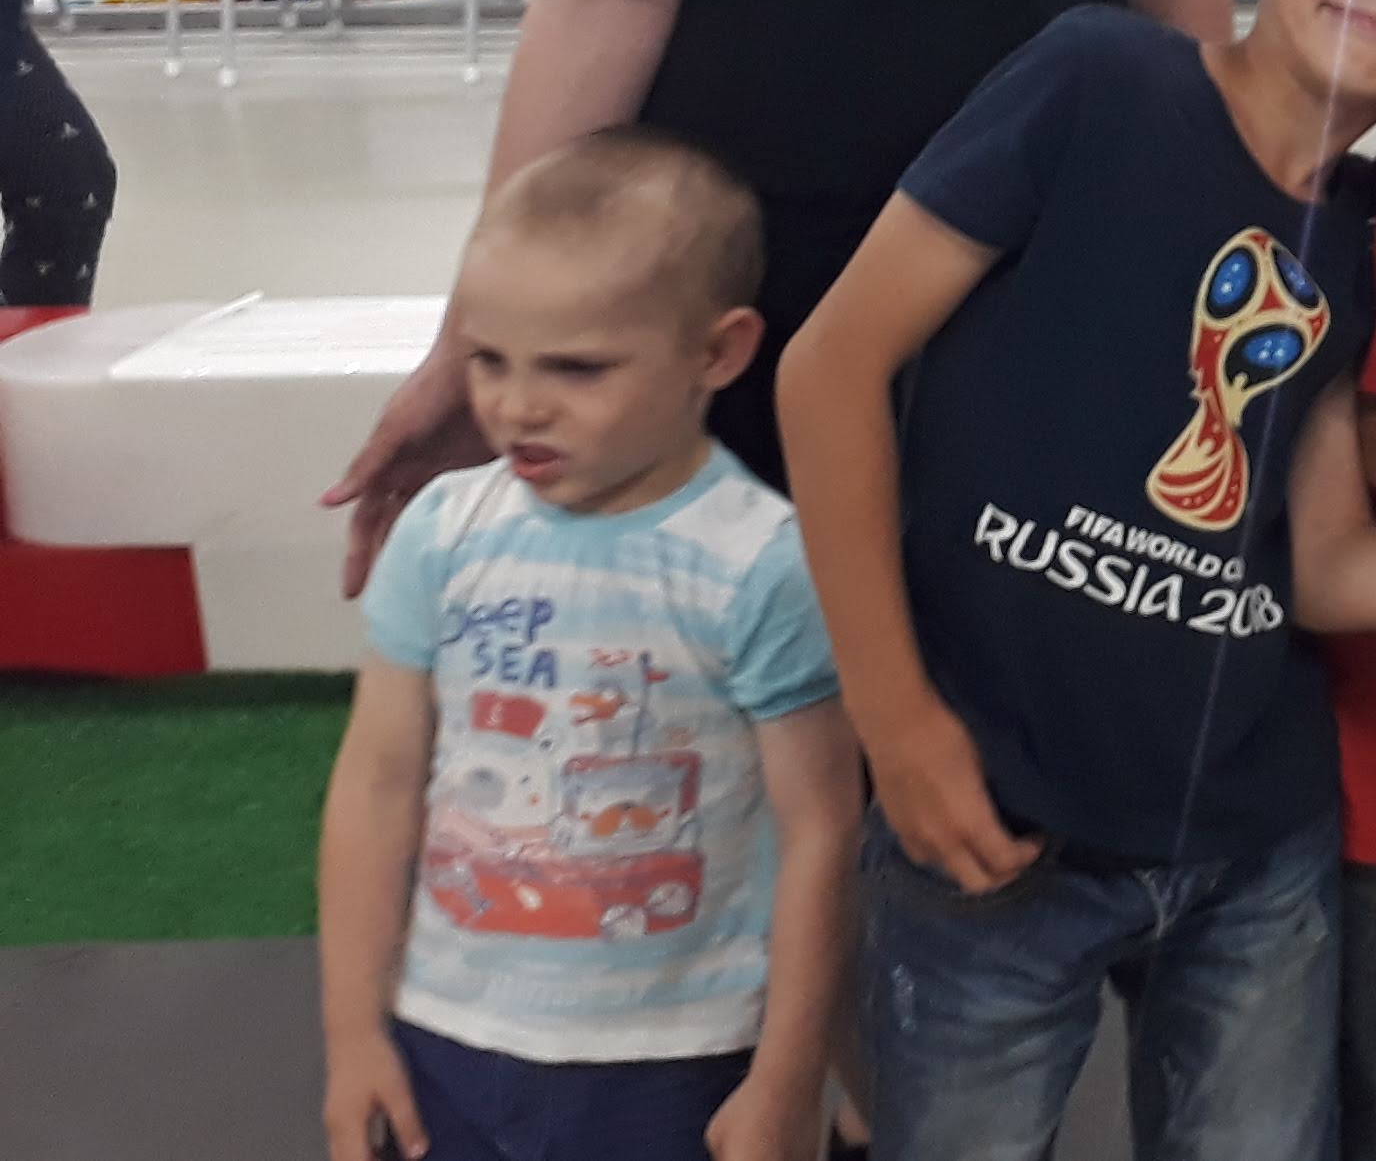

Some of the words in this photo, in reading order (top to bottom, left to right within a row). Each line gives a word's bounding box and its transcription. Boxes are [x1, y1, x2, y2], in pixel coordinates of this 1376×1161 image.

[973, 501, 1185, 624] RUSSIA
[1124, 524, 1223, 580] WORLD
[471, 639, 559, 689] SEA
